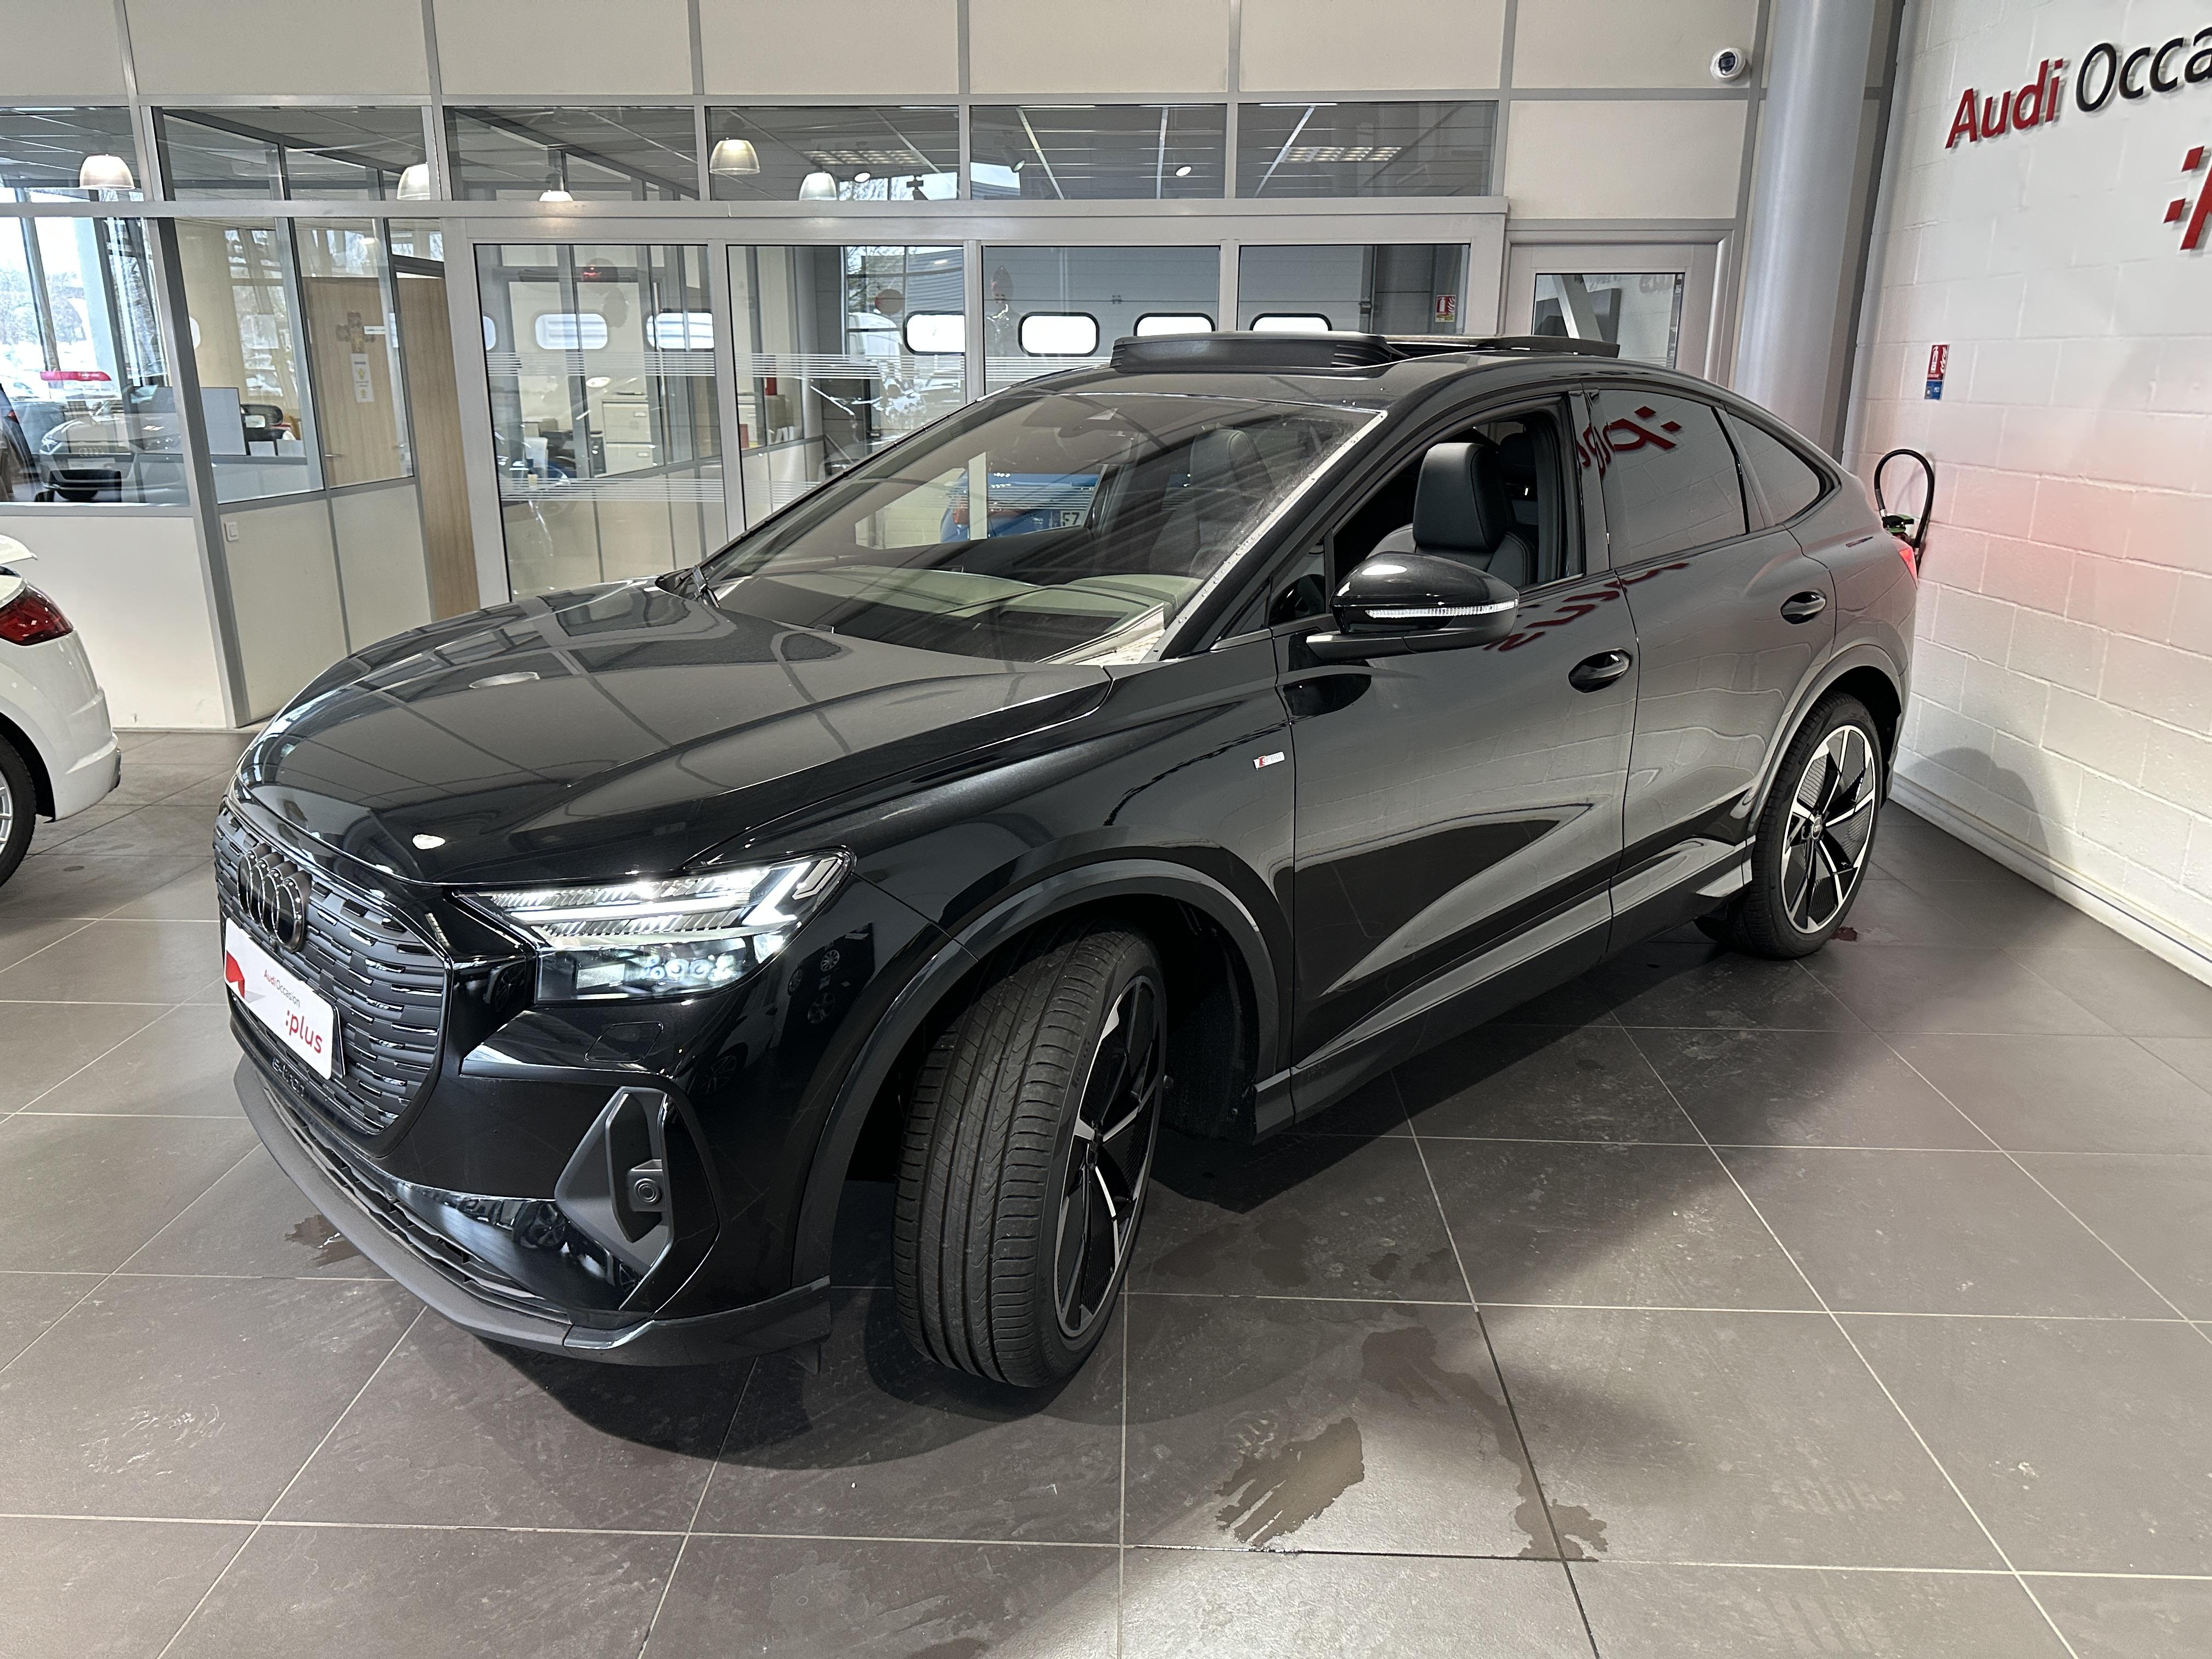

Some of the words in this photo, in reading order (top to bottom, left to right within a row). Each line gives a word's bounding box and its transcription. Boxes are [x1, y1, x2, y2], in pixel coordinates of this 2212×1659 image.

[1945, 58, 2063, 149] Audi
[264, 969, 276, 987] Audi
[276, 980, 300, 1008] Occasion
